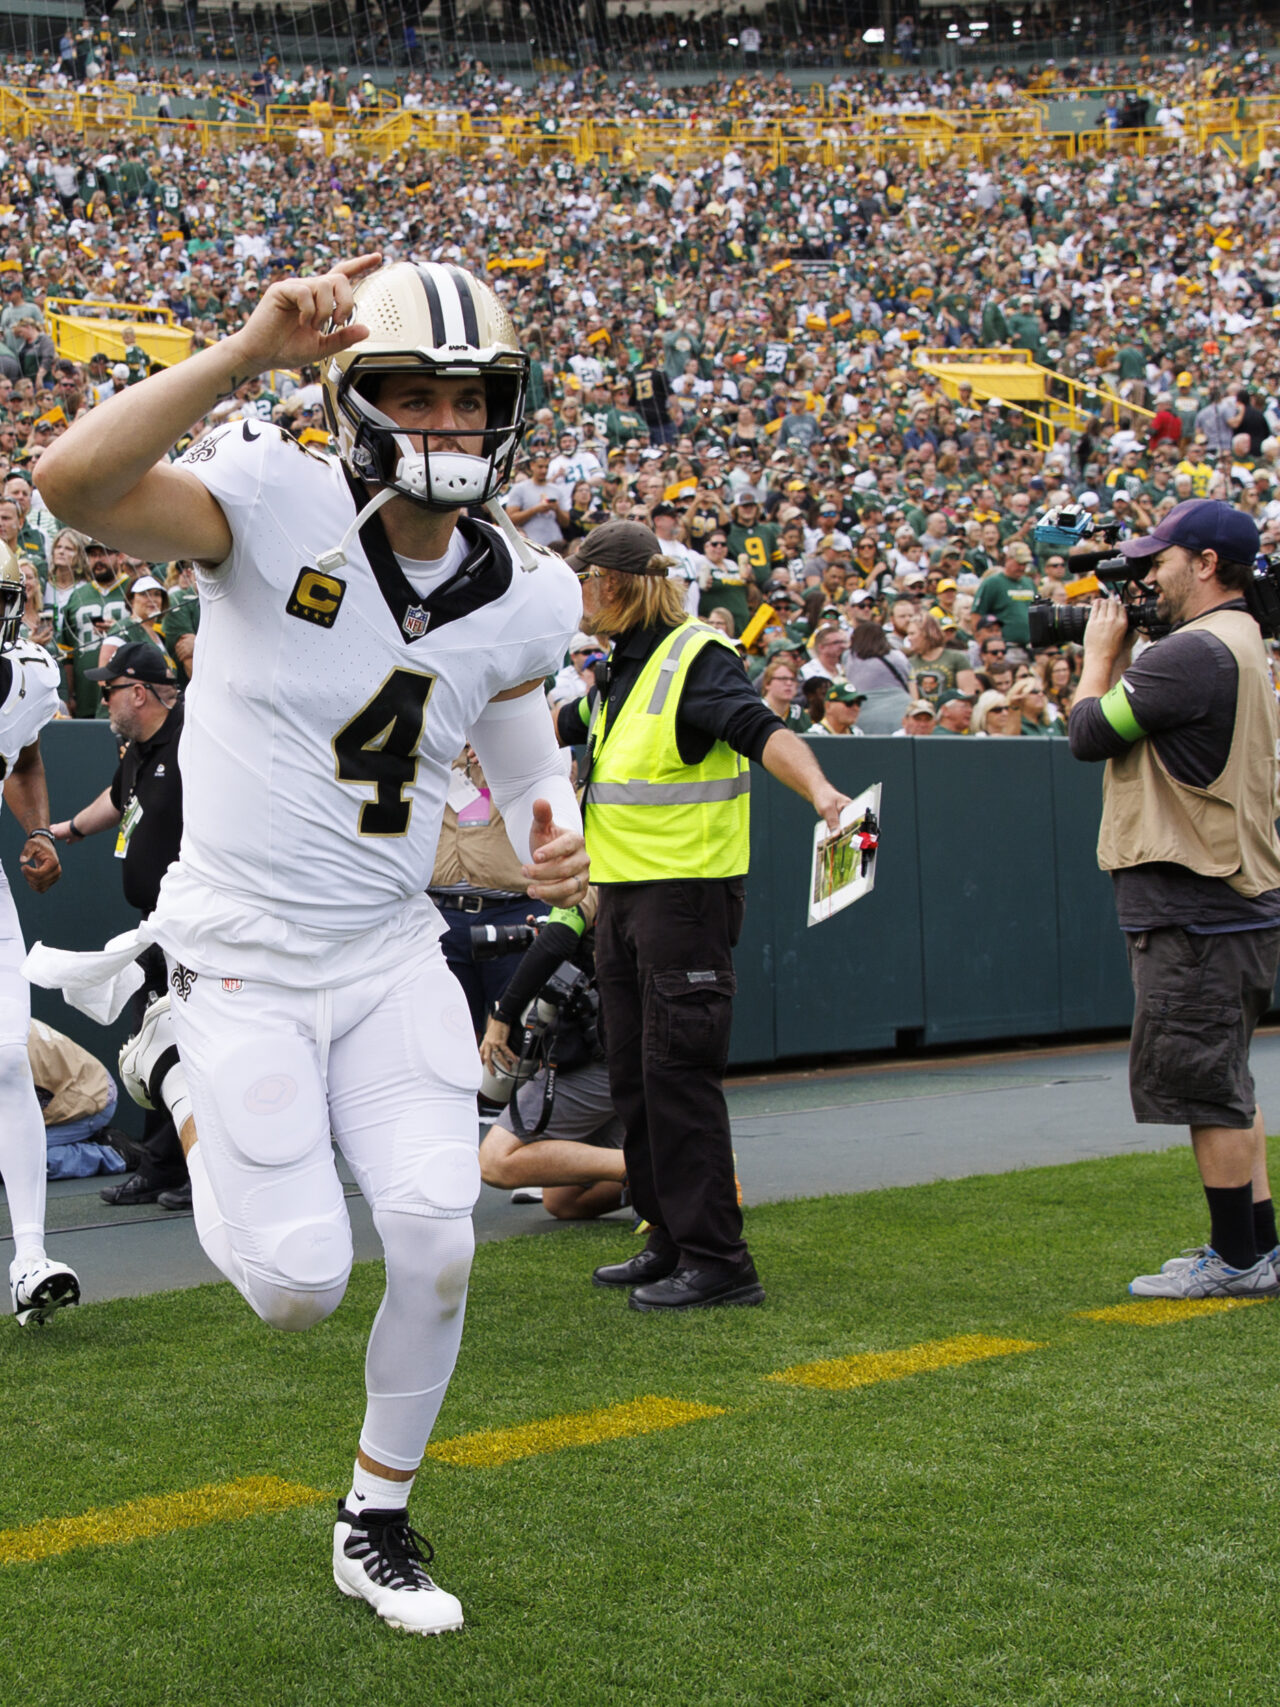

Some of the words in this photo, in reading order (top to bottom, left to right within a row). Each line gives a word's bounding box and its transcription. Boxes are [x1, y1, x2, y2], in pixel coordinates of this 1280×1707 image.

[635, 379, 654, 401] 13
[565, 463, 586, 484] 21
[744, 536, 768, 566] 9
[295, 571, 343, 615] C
[405, 616, 425, 633] NFL
[330, 664, 438, 838] 4
[222, 978, 240, 991] NFL
[545, 1069, 556, 1101] SONY
